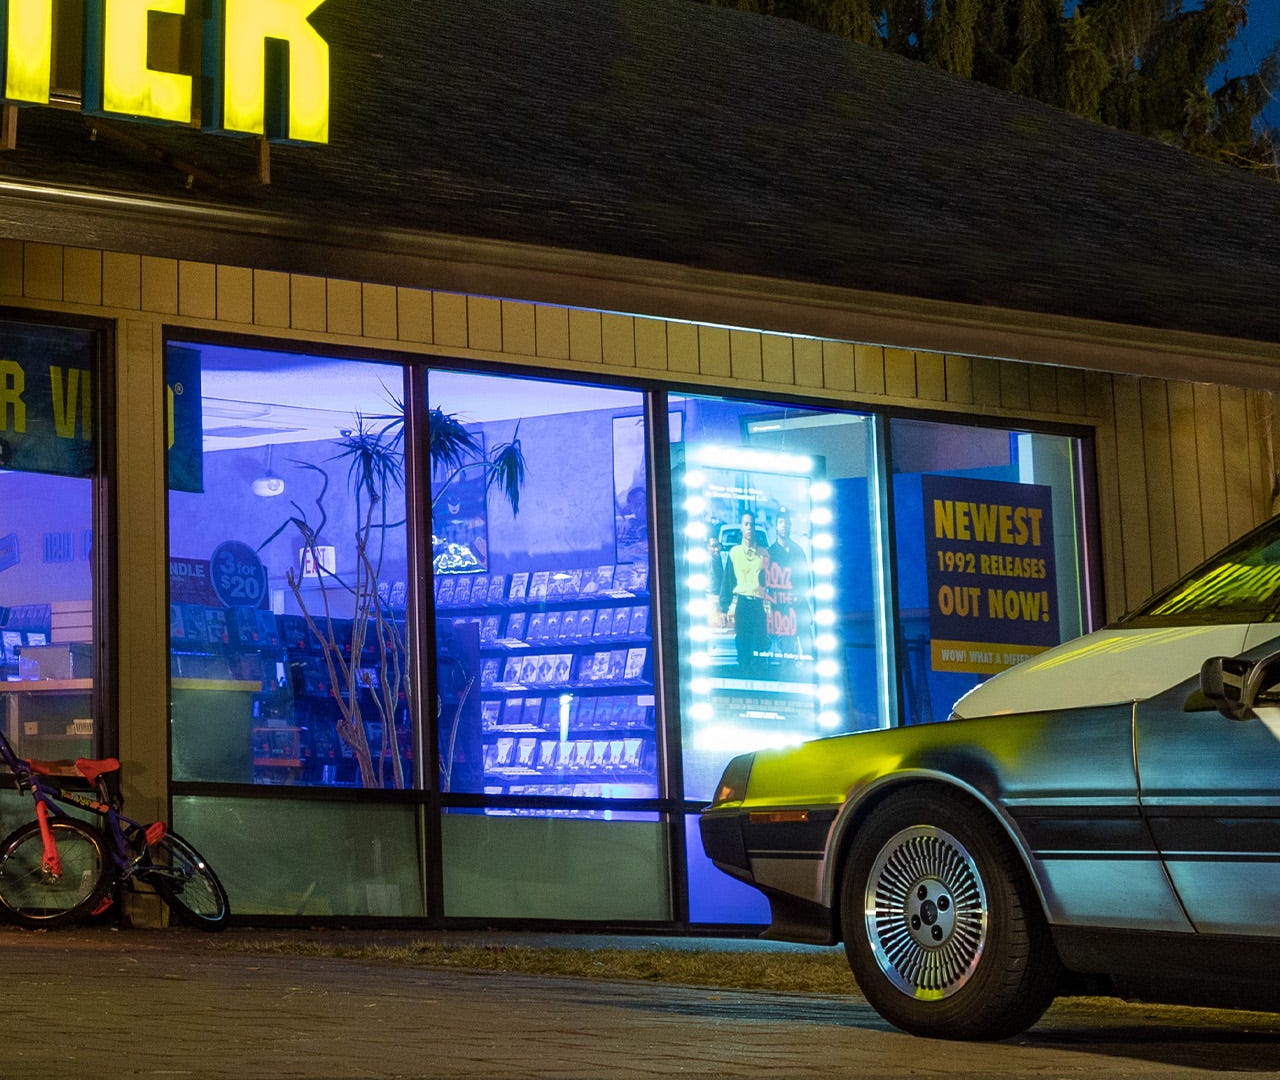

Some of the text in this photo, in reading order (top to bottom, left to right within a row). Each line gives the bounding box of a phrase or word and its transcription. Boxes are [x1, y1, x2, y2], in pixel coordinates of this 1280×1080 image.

[934, 500, 1042, 547] NEWEST
[219, 550, 257, 575] 3 for
[937, 550, 1047, 580] 1992 RELEASES
[221, 575, 260, 600] $20
[938, 584, 1050, 623] OUT NOW!
[941, 648, 967, 663] WOW!
[969, 650, 993, 664] WHAT
[995, 652, 1002, 665] A
